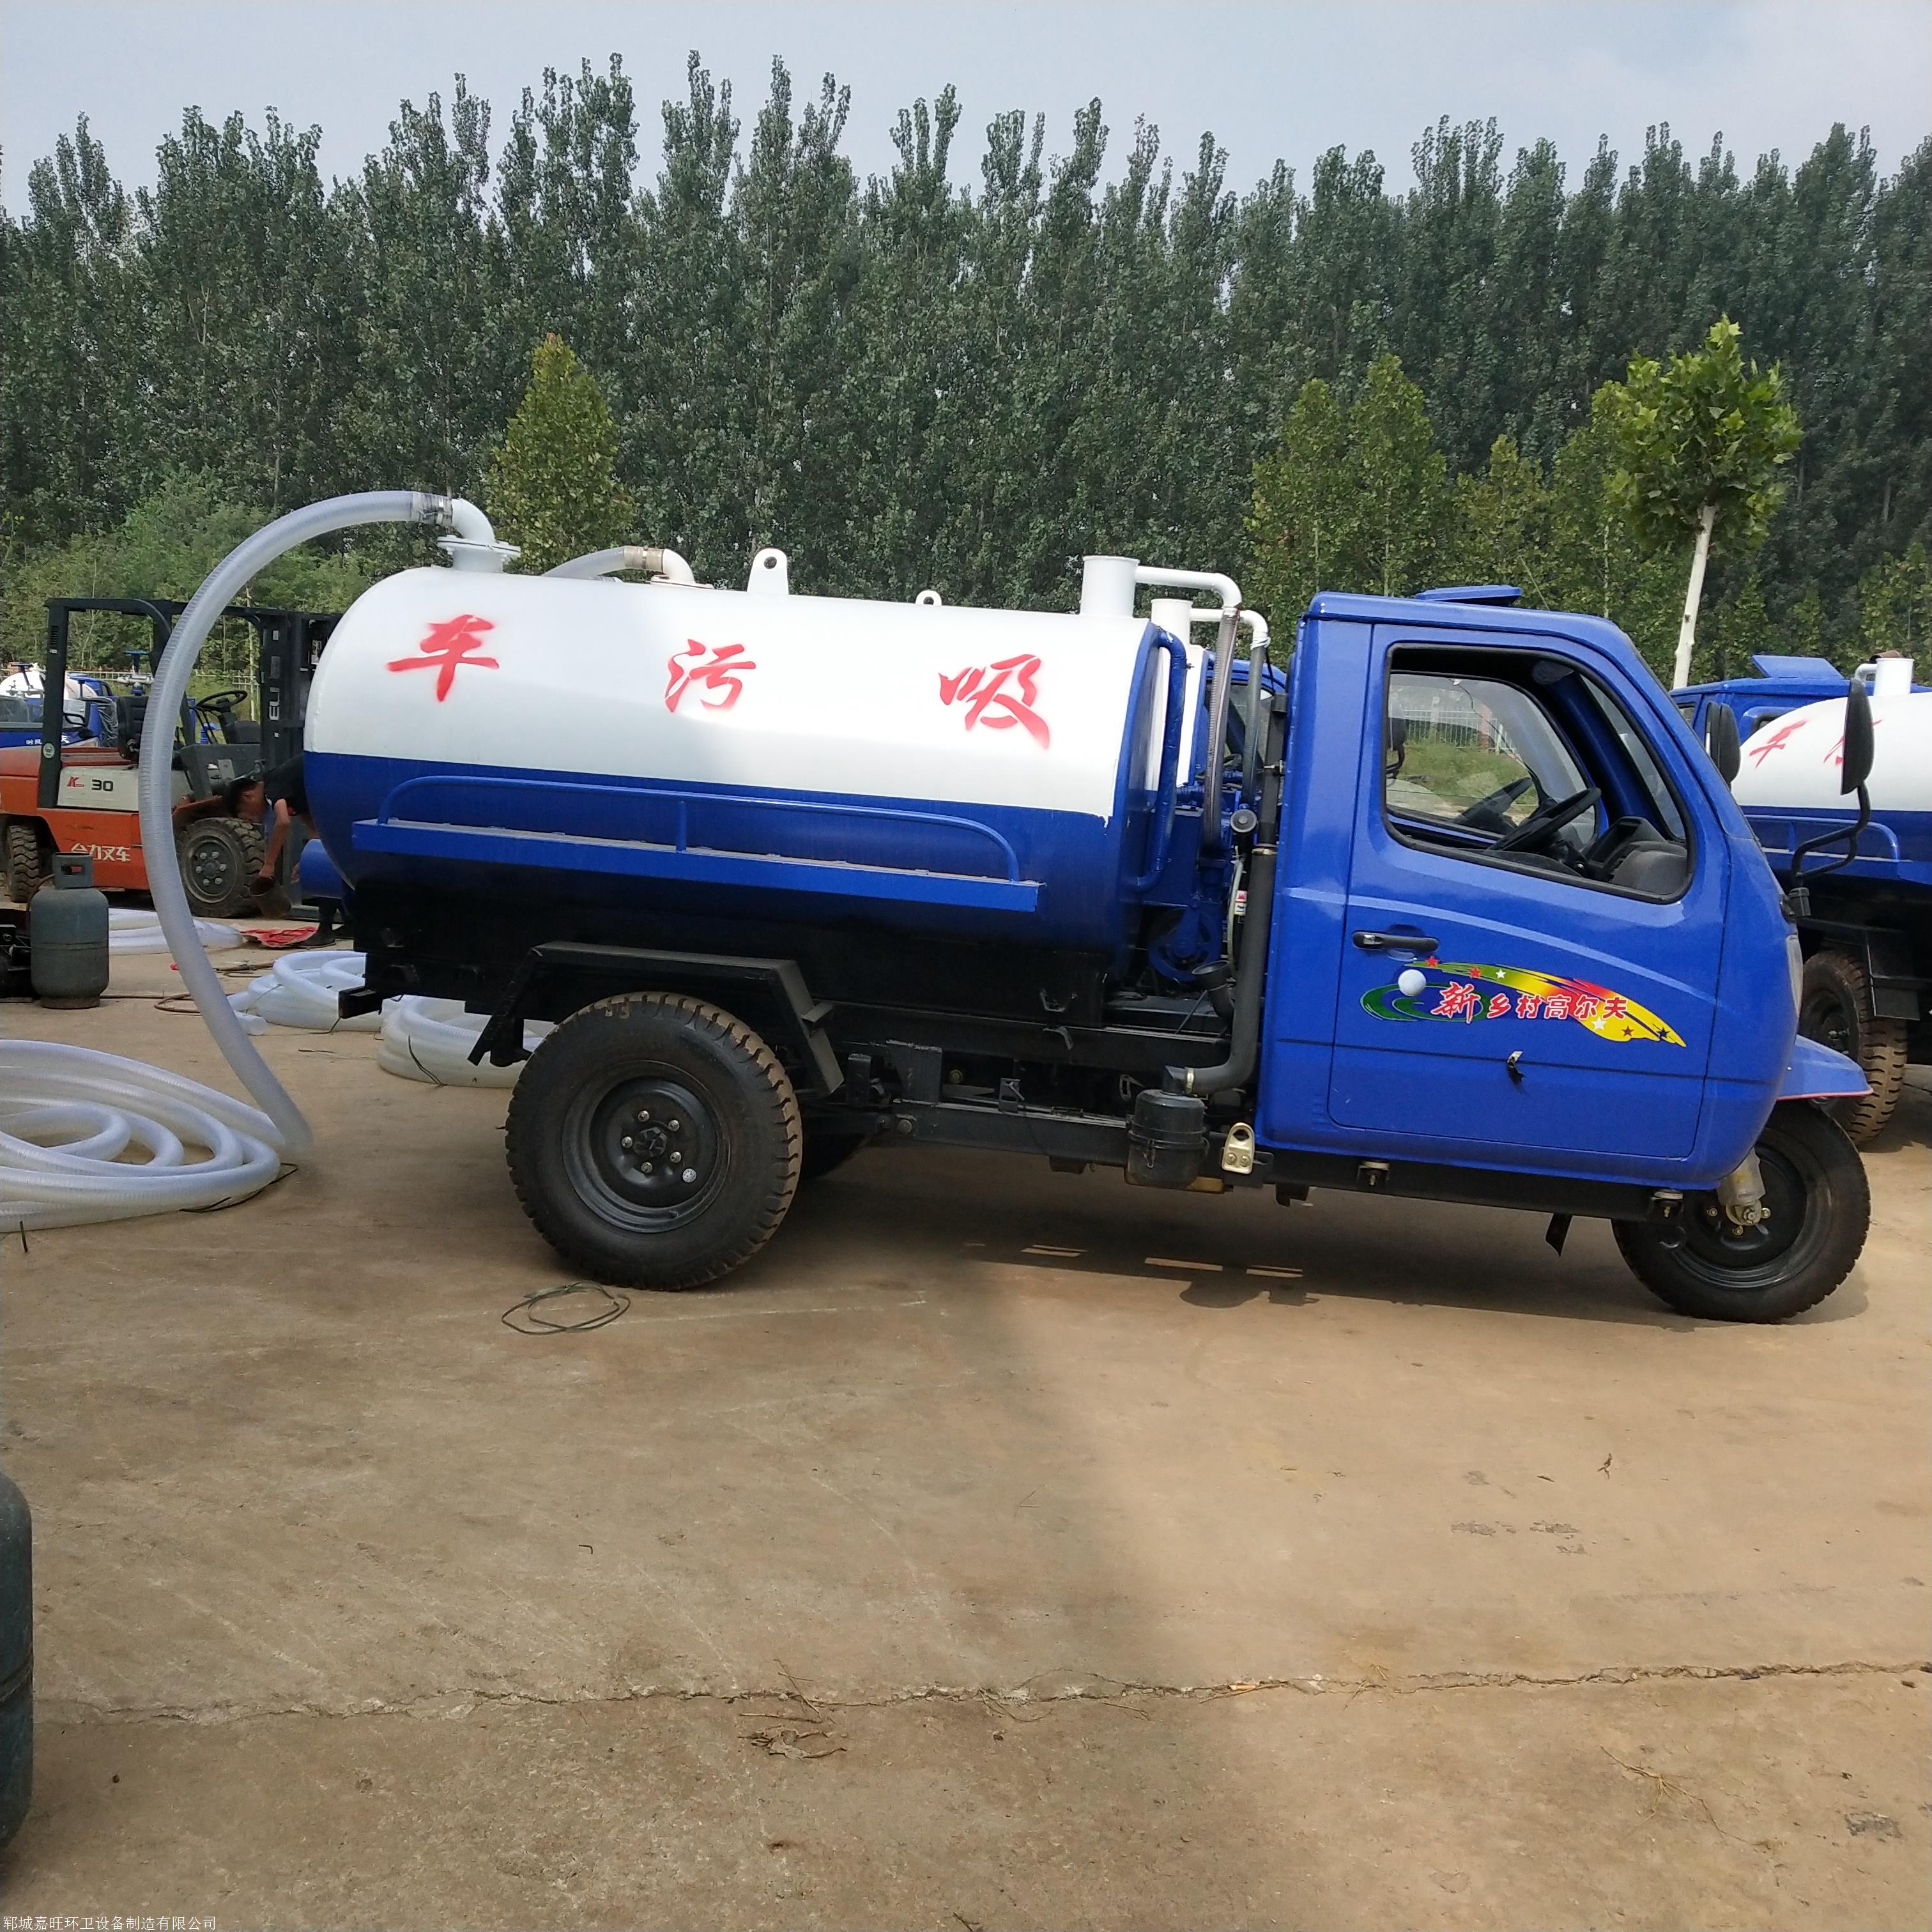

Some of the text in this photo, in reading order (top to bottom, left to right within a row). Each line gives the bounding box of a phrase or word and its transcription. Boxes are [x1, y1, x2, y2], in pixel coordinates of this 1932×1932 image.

[91, 779, 114, 792] 30
[1430, 981, 1629, 1023] 新乡村高尔夫
